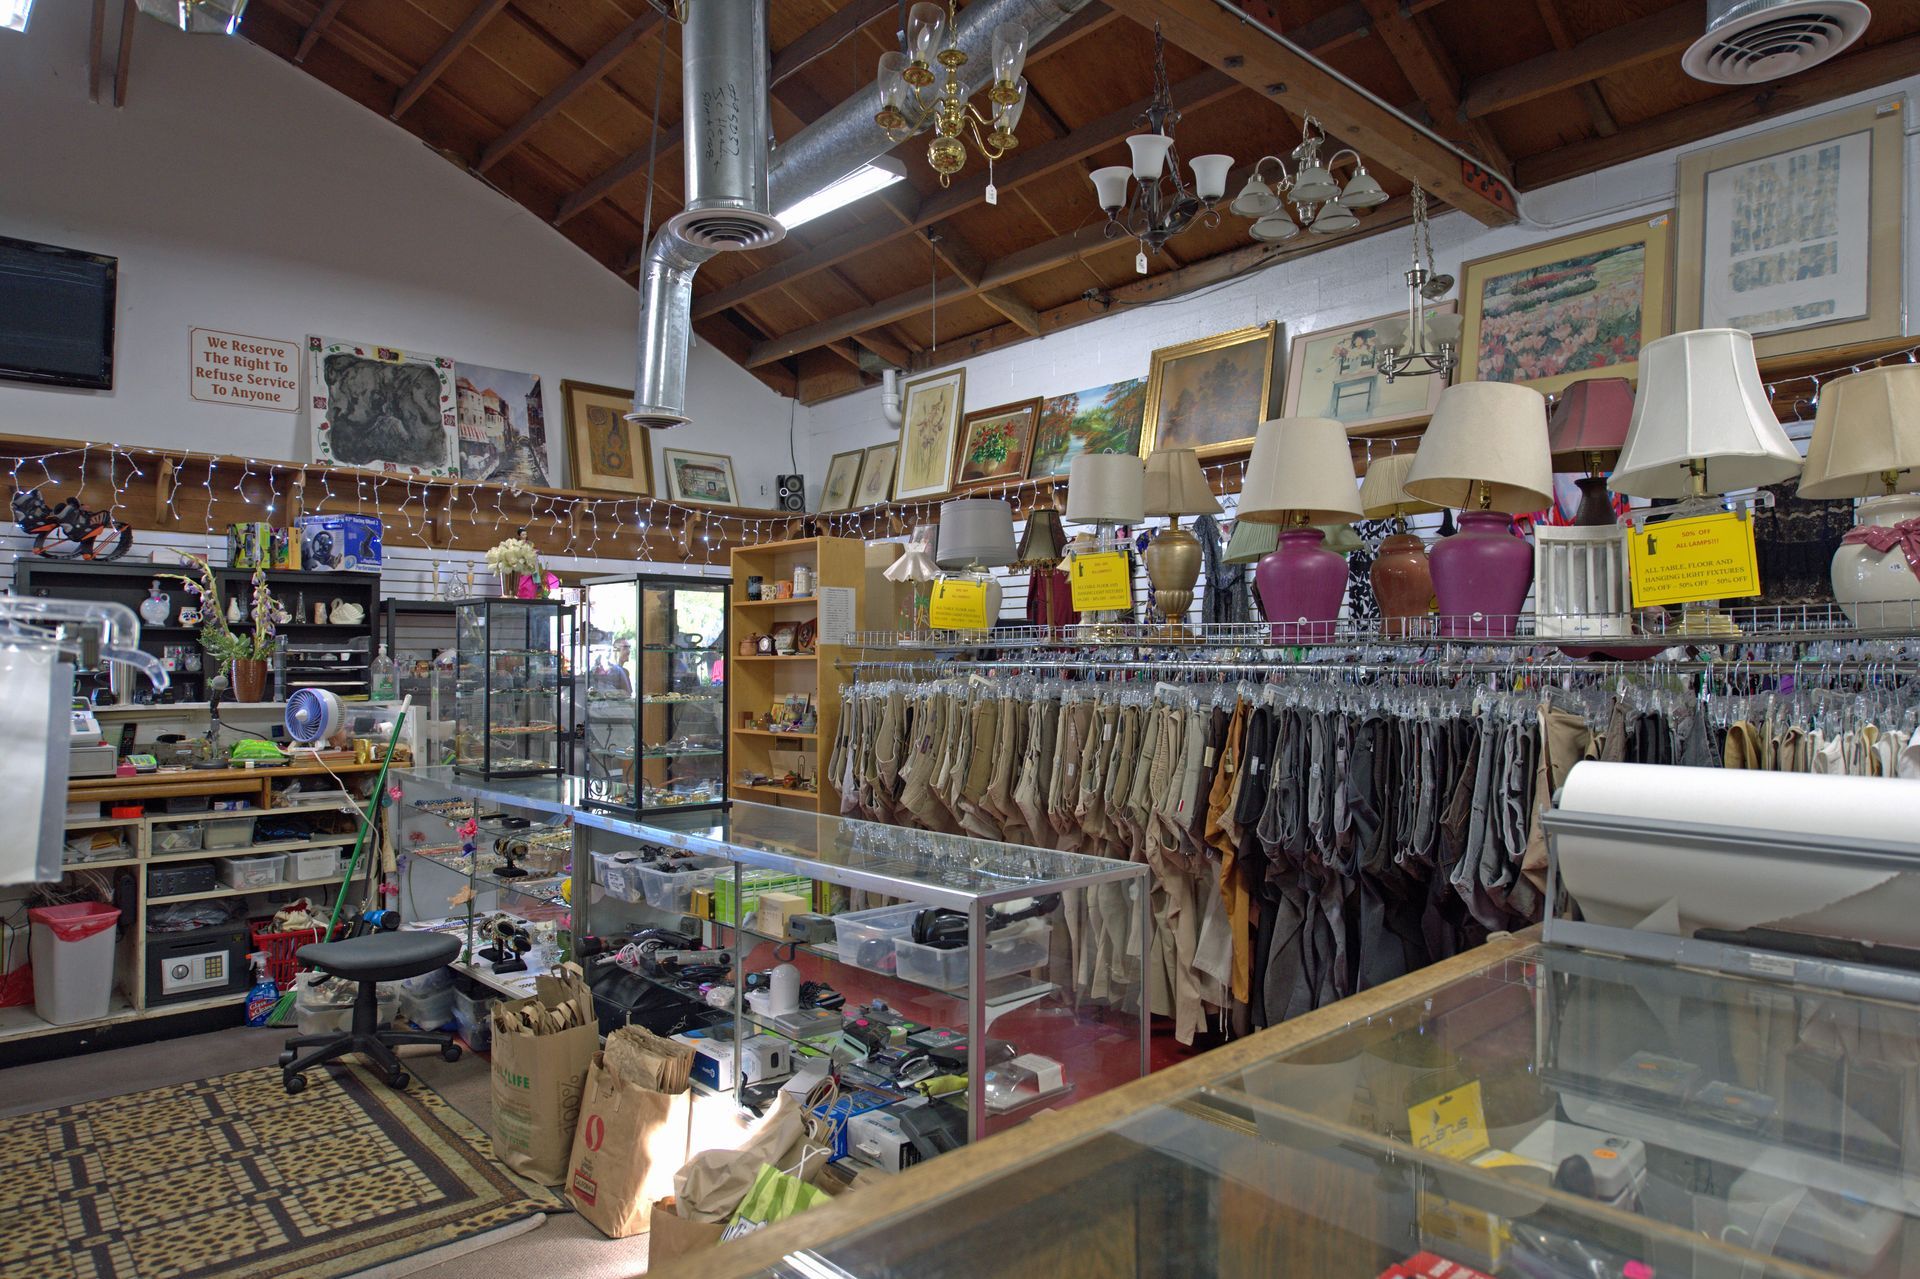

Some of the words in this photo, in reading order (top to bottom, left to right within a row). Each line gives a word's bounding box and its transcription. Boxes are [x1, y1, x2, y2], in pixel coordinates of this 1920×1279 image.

[207, 336, 228, 350] We
[232, 340, 285, 358] Reserve
[203, 351, 230, 365] The
[234, 355, 271, 371] Right
[273, 361, 288, 374] To
[195, 366, 244, 383] Refuse
[247, 373, 296, 390] Service
[211, 383, 227, 396] To
[231, 386, 281, 402] Anyone
[1681, 530, 1696, 538] 50%
[1698, 528, 1711, 536] OFF
[1689, 538, 1720, 548] LAMPS!!!
[1688, 561, 1714, 570] FLOOR
[1716, 558, 1734, 566] AND
[1645, 574, 1681, 583] HANGING
[1681, 571, 1704, 580] LIGHT
[1705, 566, 1745, 578] FIXTURES
[1642, 585, 1657, 593] 50%
[1678, 581, 1694, 589] 50%
[1716, 577, 1732, 585] 50%
[1733, 575, 1748, 583] OFF
[507, 1071, 530, 1089] LIFE
